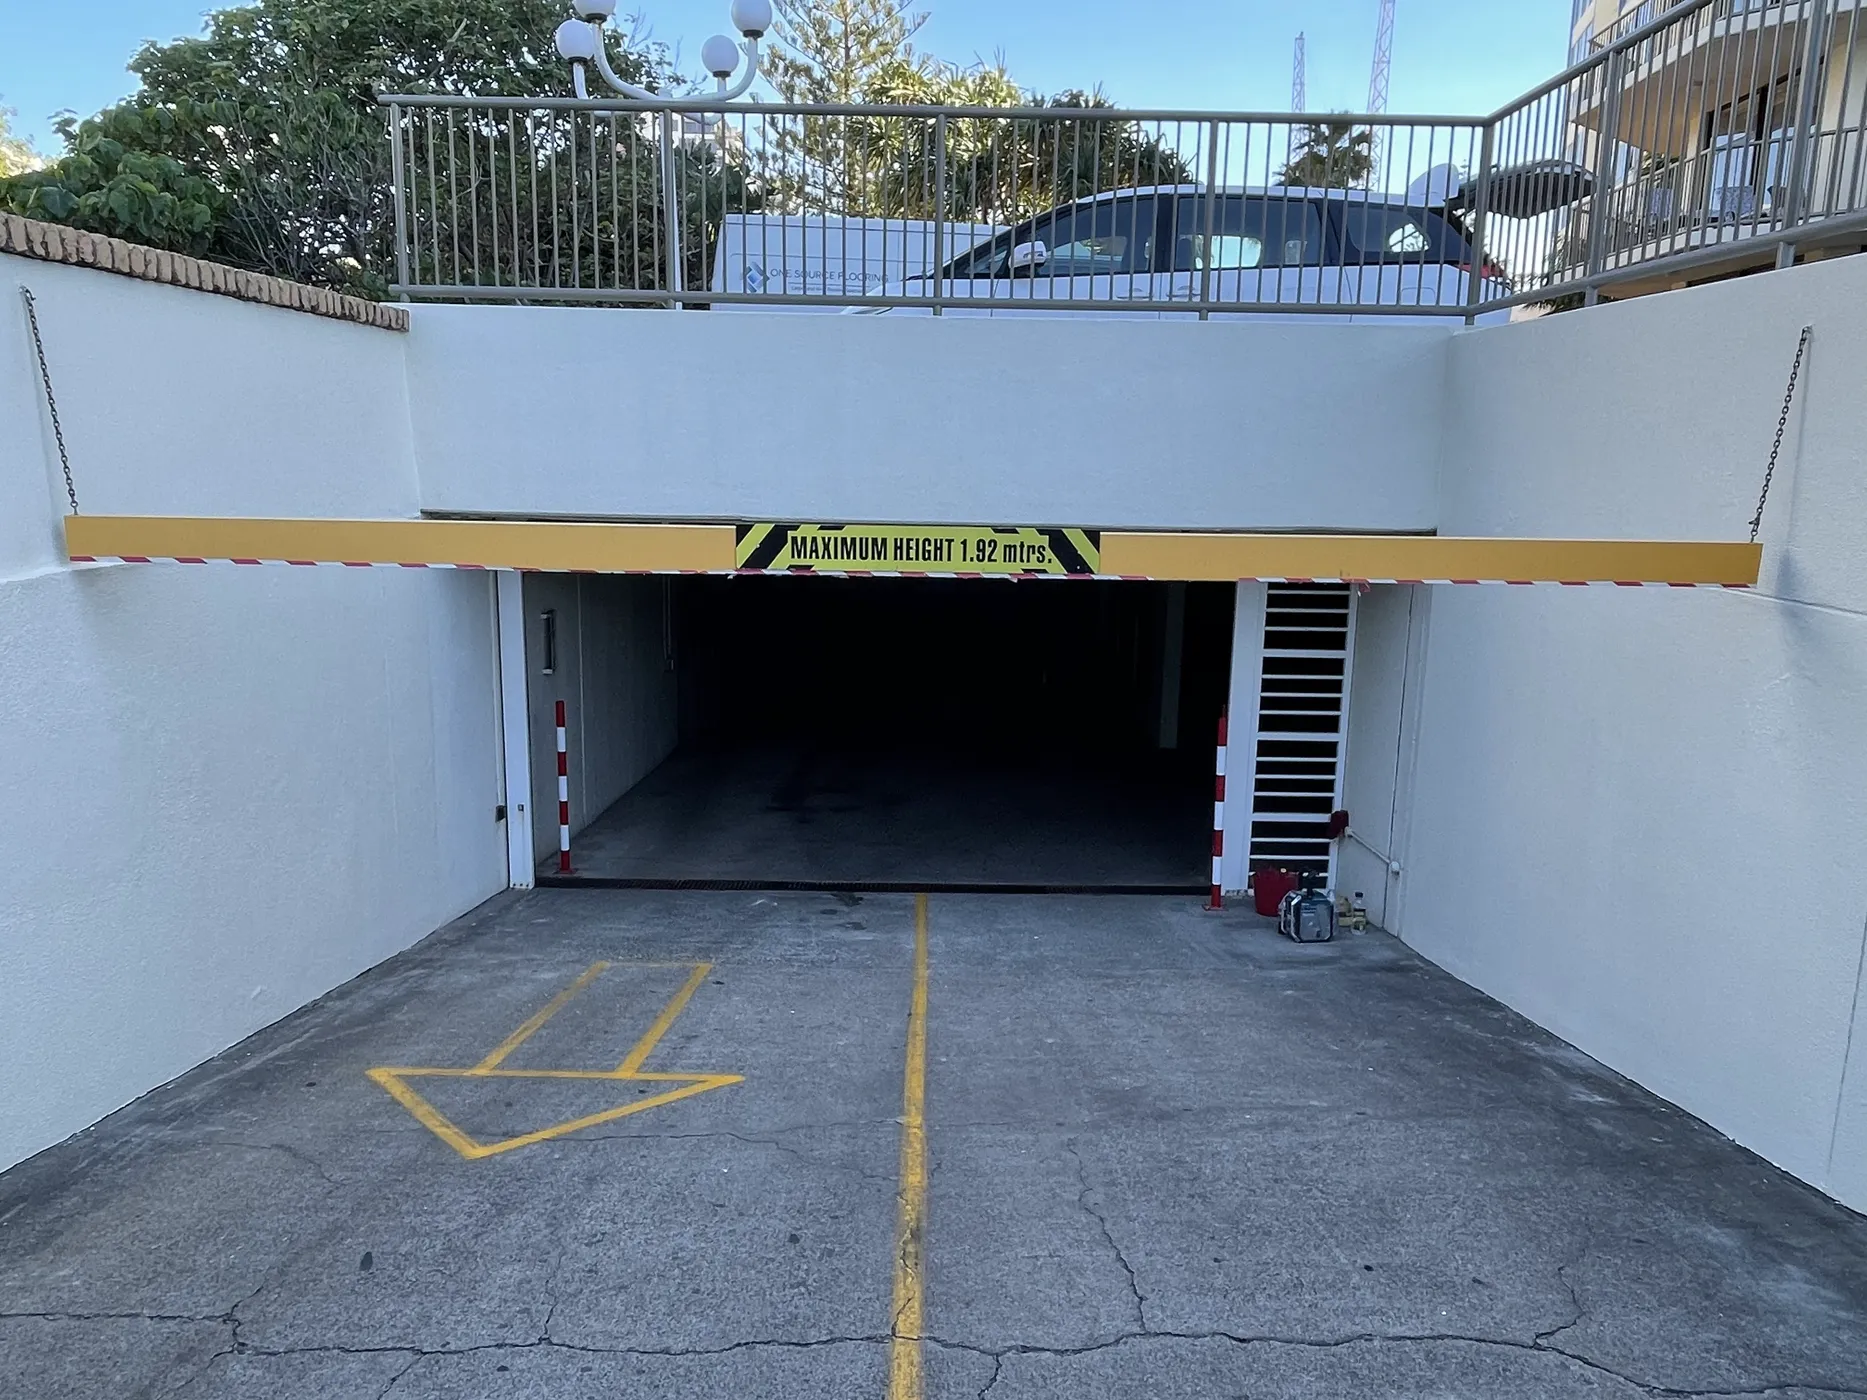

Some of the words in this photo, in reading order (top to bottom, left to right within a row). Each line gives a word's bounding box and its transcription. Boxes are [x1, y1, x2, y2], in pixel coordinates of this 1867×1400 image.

[770, 268, 792, 278] ONE
[790, 536, 888, 561] MAXIMUM
[893, 537, 955, 562] HEIGHT
[960, 538, 998, 563] 1.92
[1003, 541, 1052, 564] mtrs.
